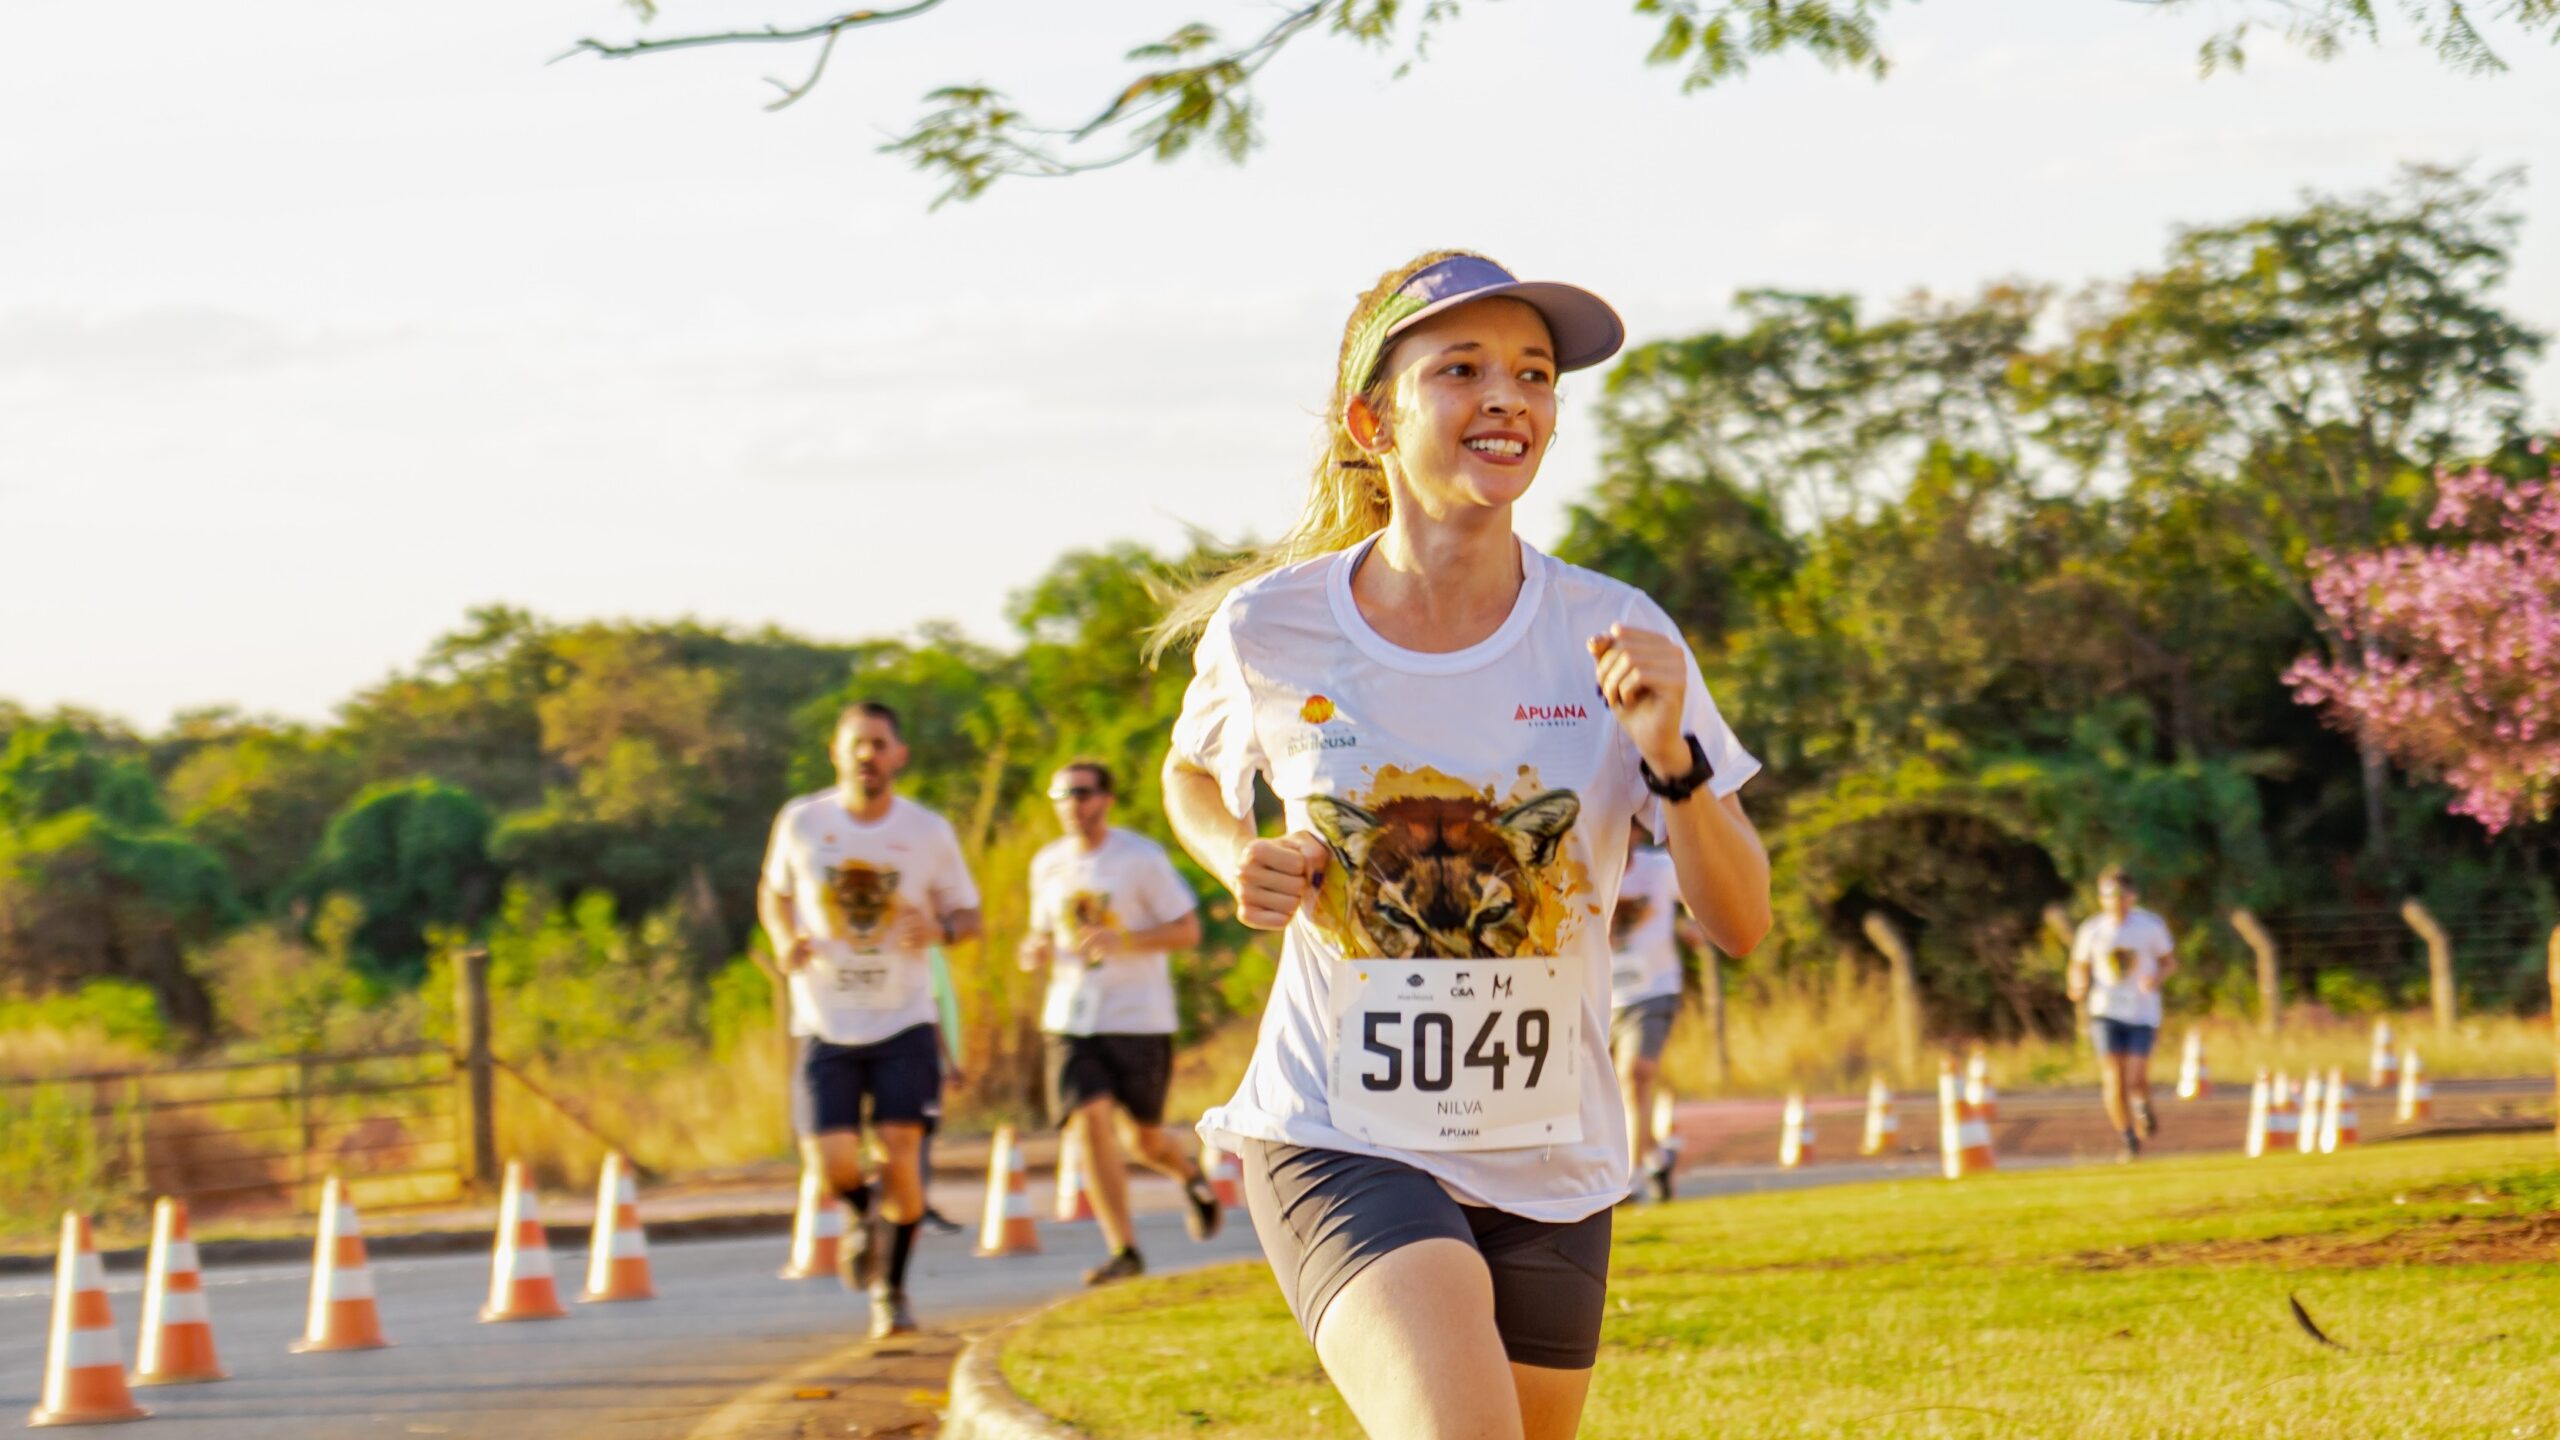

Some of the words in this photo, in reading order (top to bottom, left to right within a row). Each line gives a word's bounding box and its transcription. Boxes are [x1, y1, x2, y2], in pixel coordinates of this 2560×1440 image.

[1514, 704, 1588, 720] APUANA
[1450, 987, 1474, 997] C&A
[1362, 1009, 1550, 1092] 5049
[1437, 1100, 1483, 1115] NILVA
[1439, 1127, 1480, 1137] APUANA
